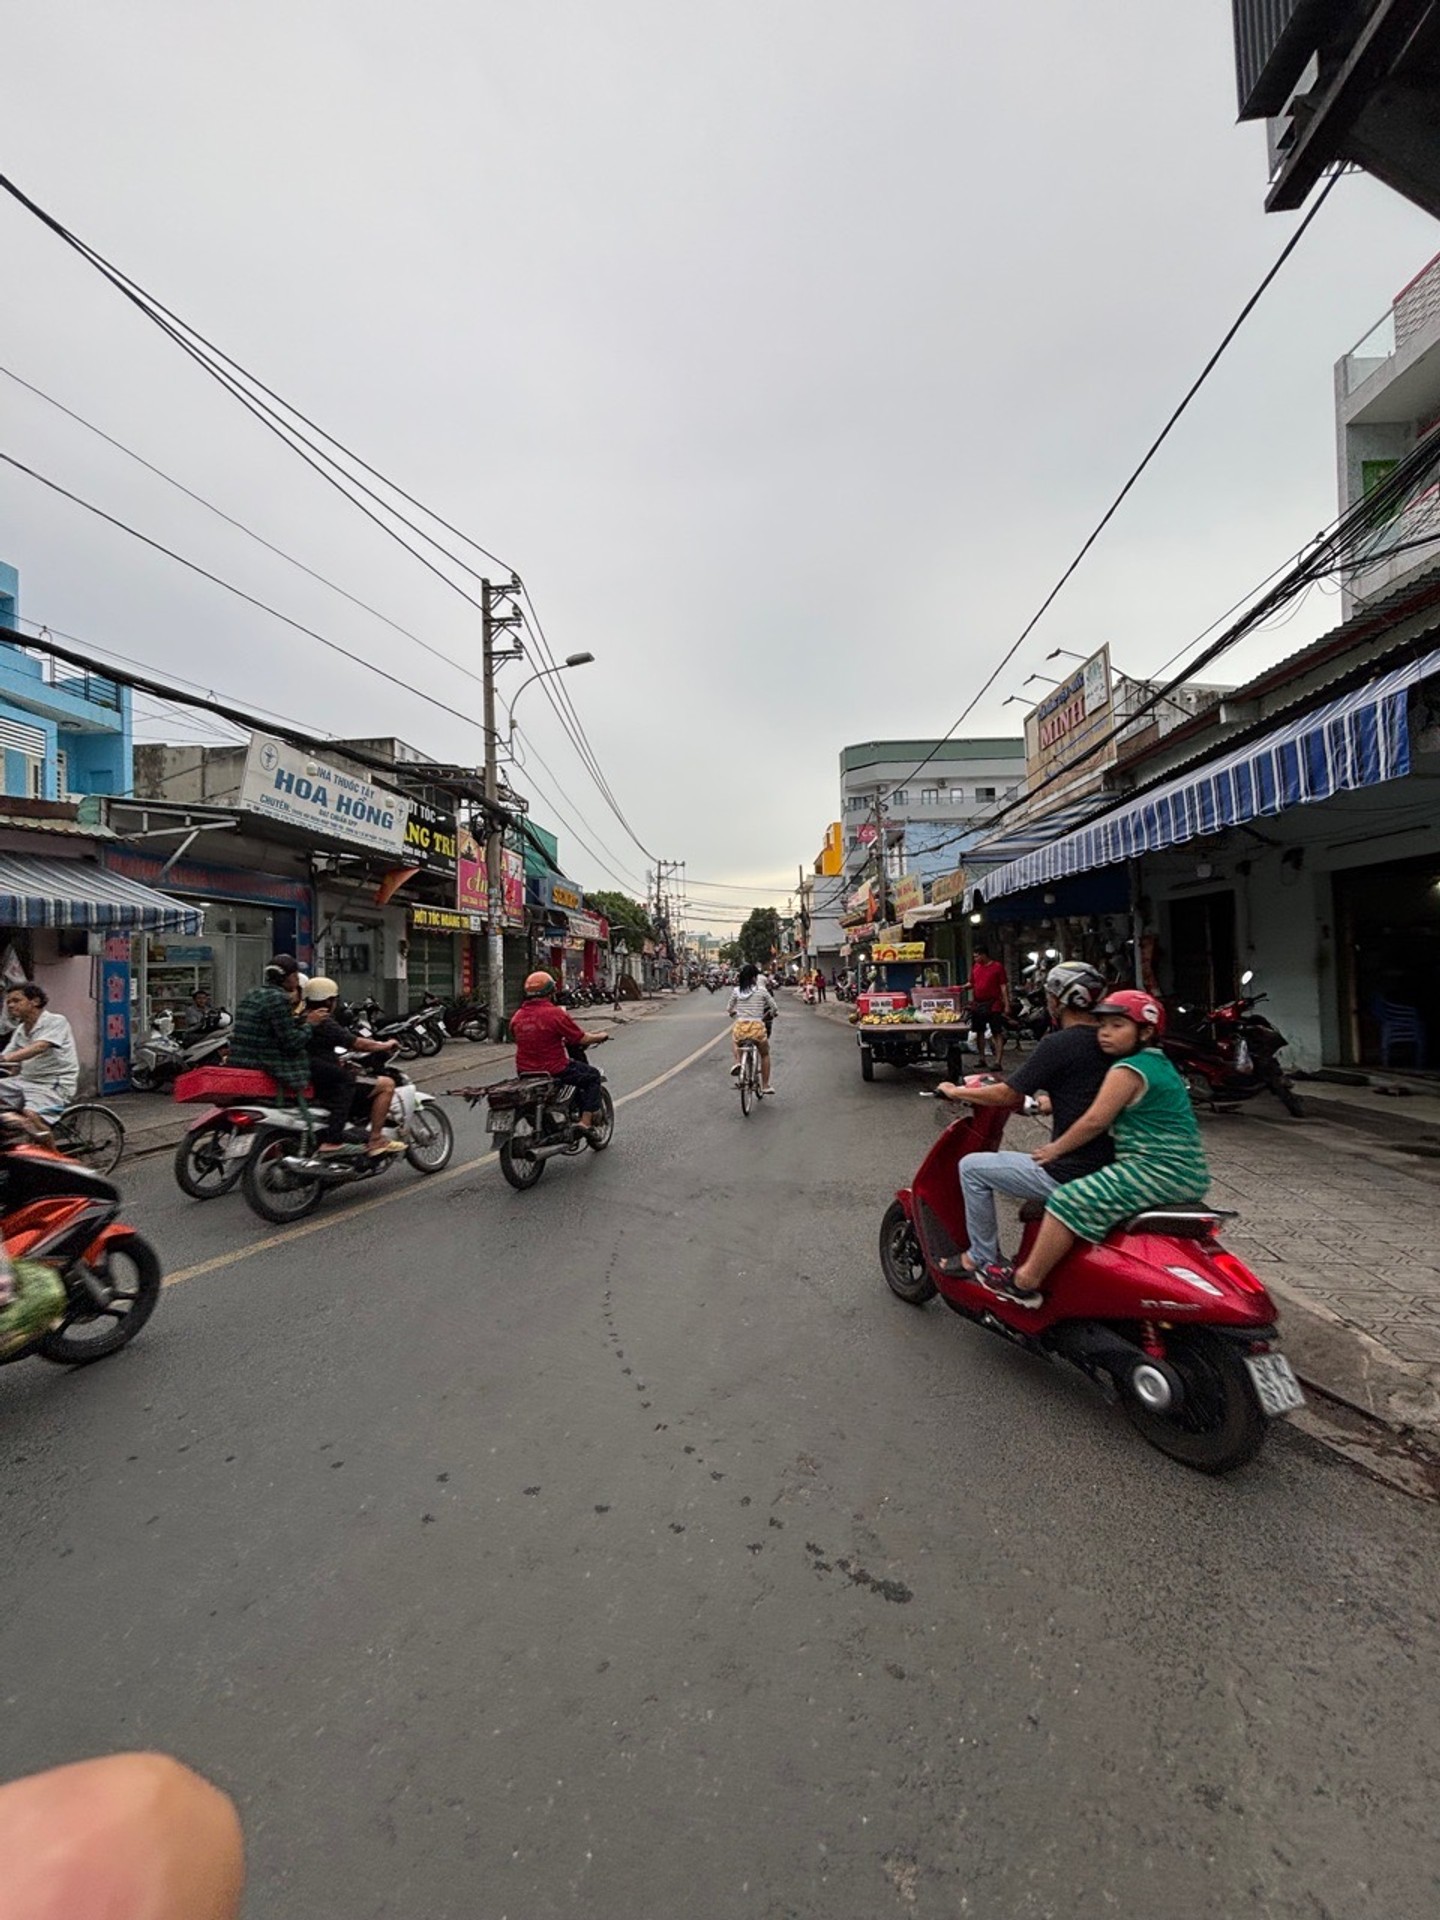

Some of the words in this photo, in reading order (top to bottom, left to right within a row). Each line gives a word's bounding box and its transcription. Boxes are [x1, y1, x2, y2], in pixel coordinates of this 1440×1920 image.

[1040, 695, 1086, 751] MINH
[274, 767, 328, 808] HOA
[335, 797, 394, 830] HỒNG
[334, 774, 360, 794] THUỐC
[361, 786, 375, 799] TÂY
[420, 805, 436, 824] TÓC
[433, 831, 456, 858] TRÍ
